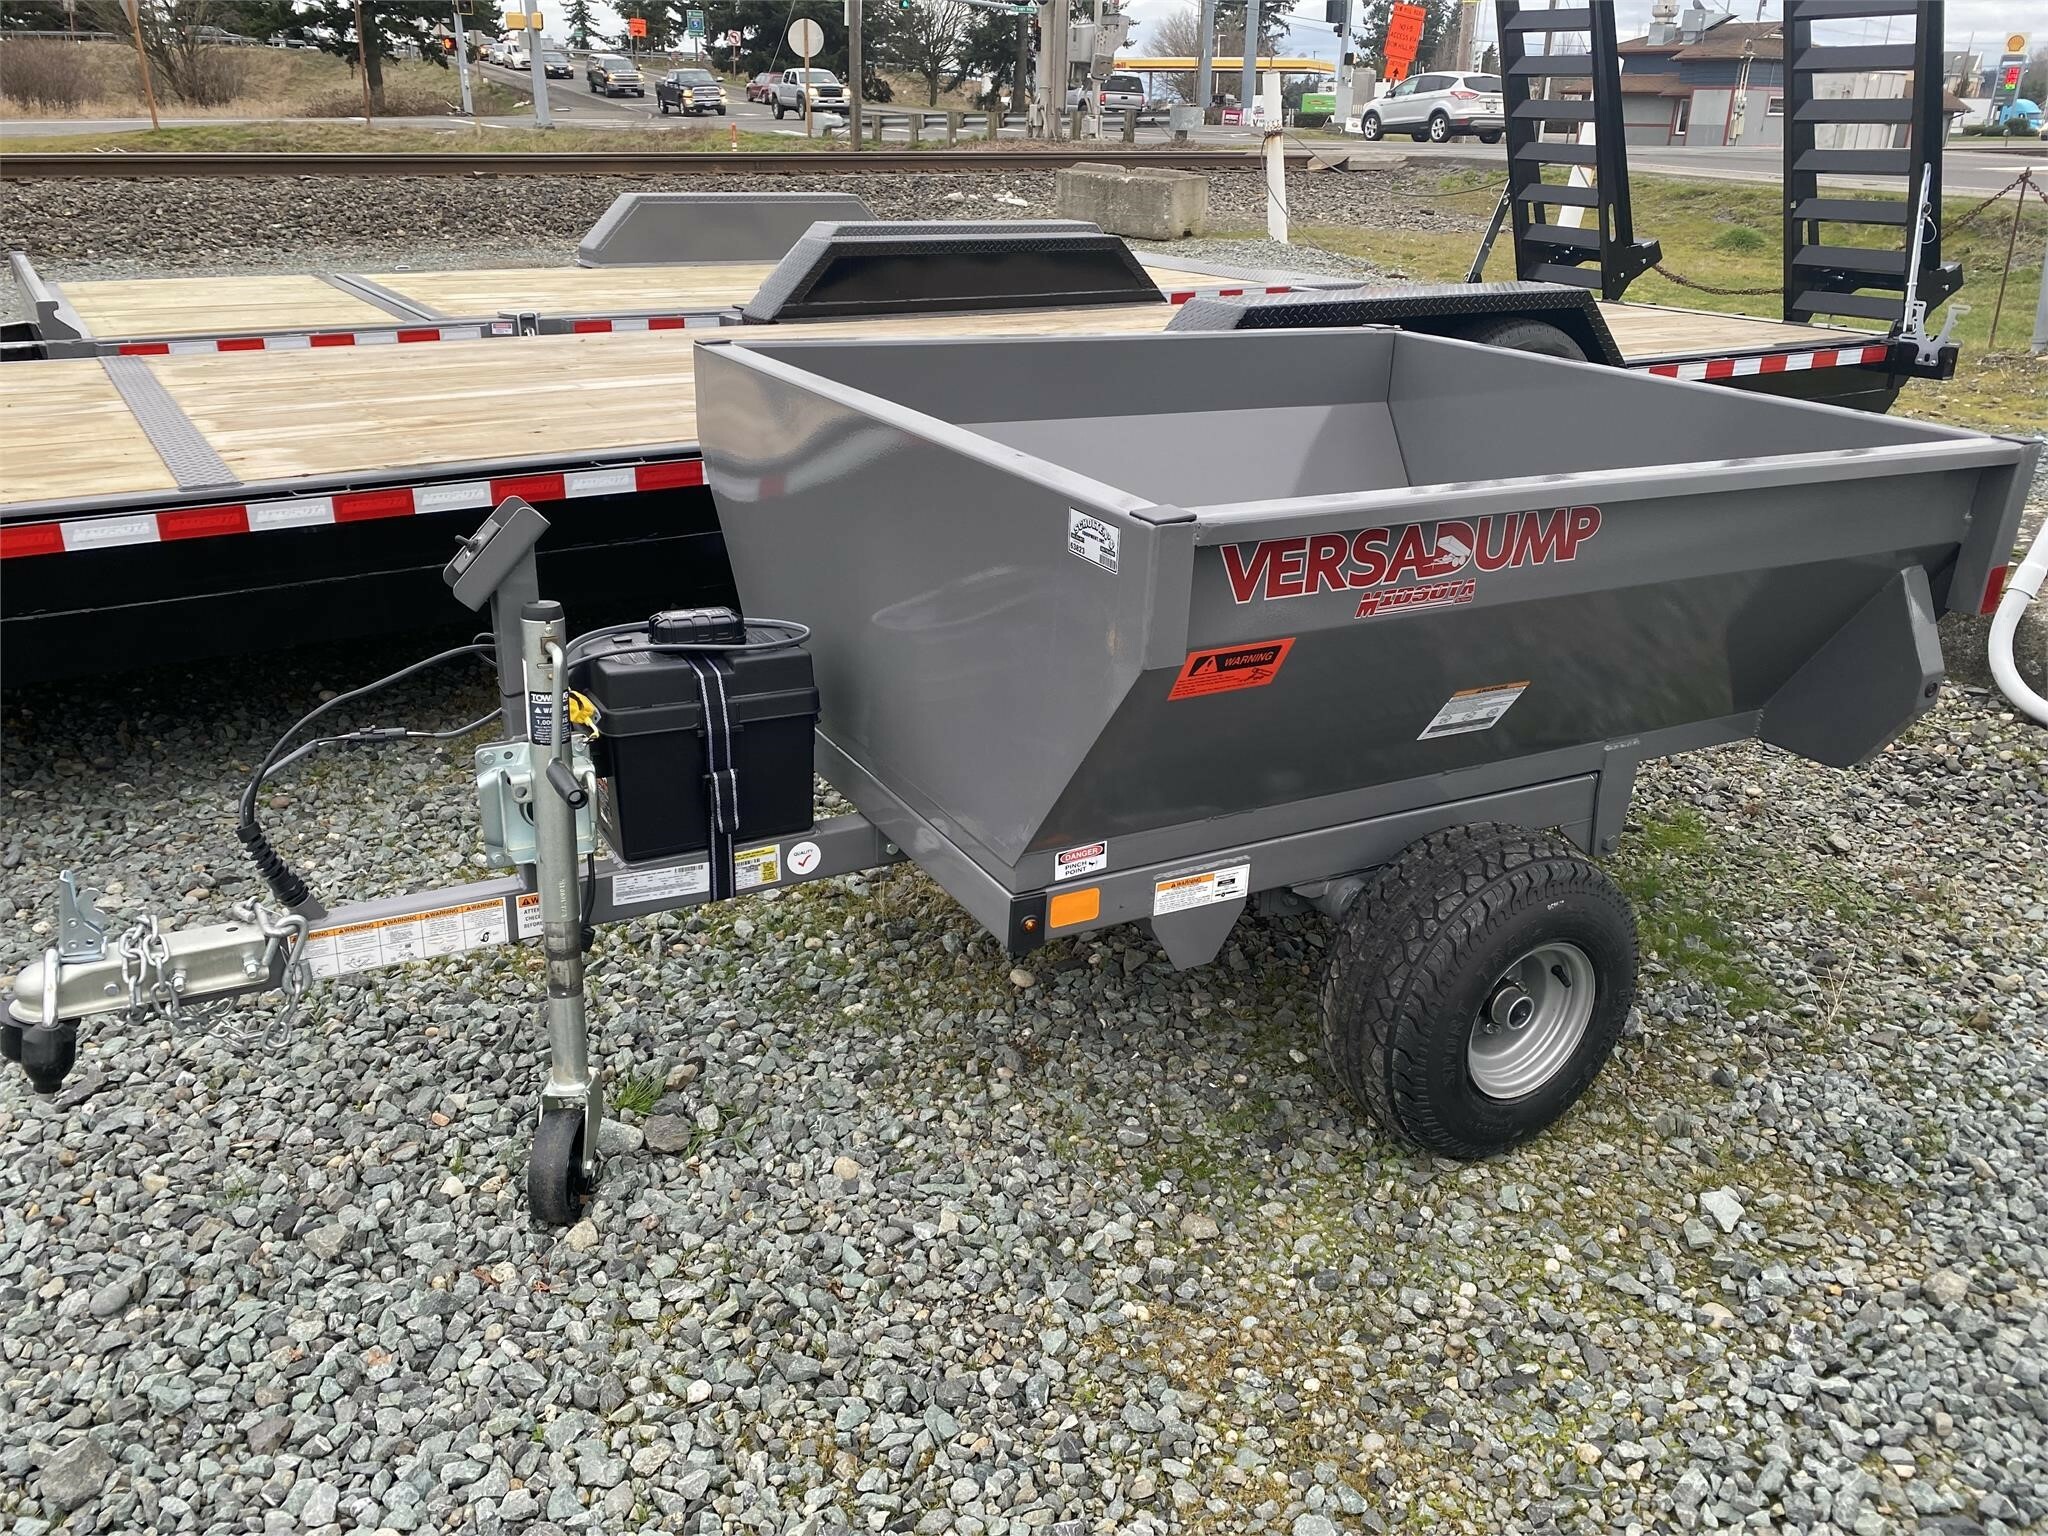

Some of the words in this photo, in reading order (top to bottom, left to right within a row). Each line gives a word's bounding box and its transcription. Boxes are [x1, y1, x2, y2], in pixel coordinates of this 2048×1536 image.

[1219, 505, 1602, 605] VERSADUMP
[1354, 578, 1476, 619] MIDSOTA
[1224, 651, 1274, 667] WARNING
[793, 849, 814, 857] QUALITY
[1065, 847, 1099, 861] DANGER
[1064, 861, 1087, 870] PINCH
[1064, 866, 1087, 876] POINT
[471, 900, 500, 911] WARNING
[429, 907, 459, 918] WARNING
[387, 915, 418, 926] WARNING
[344, 921, 374, 933] WARNING
